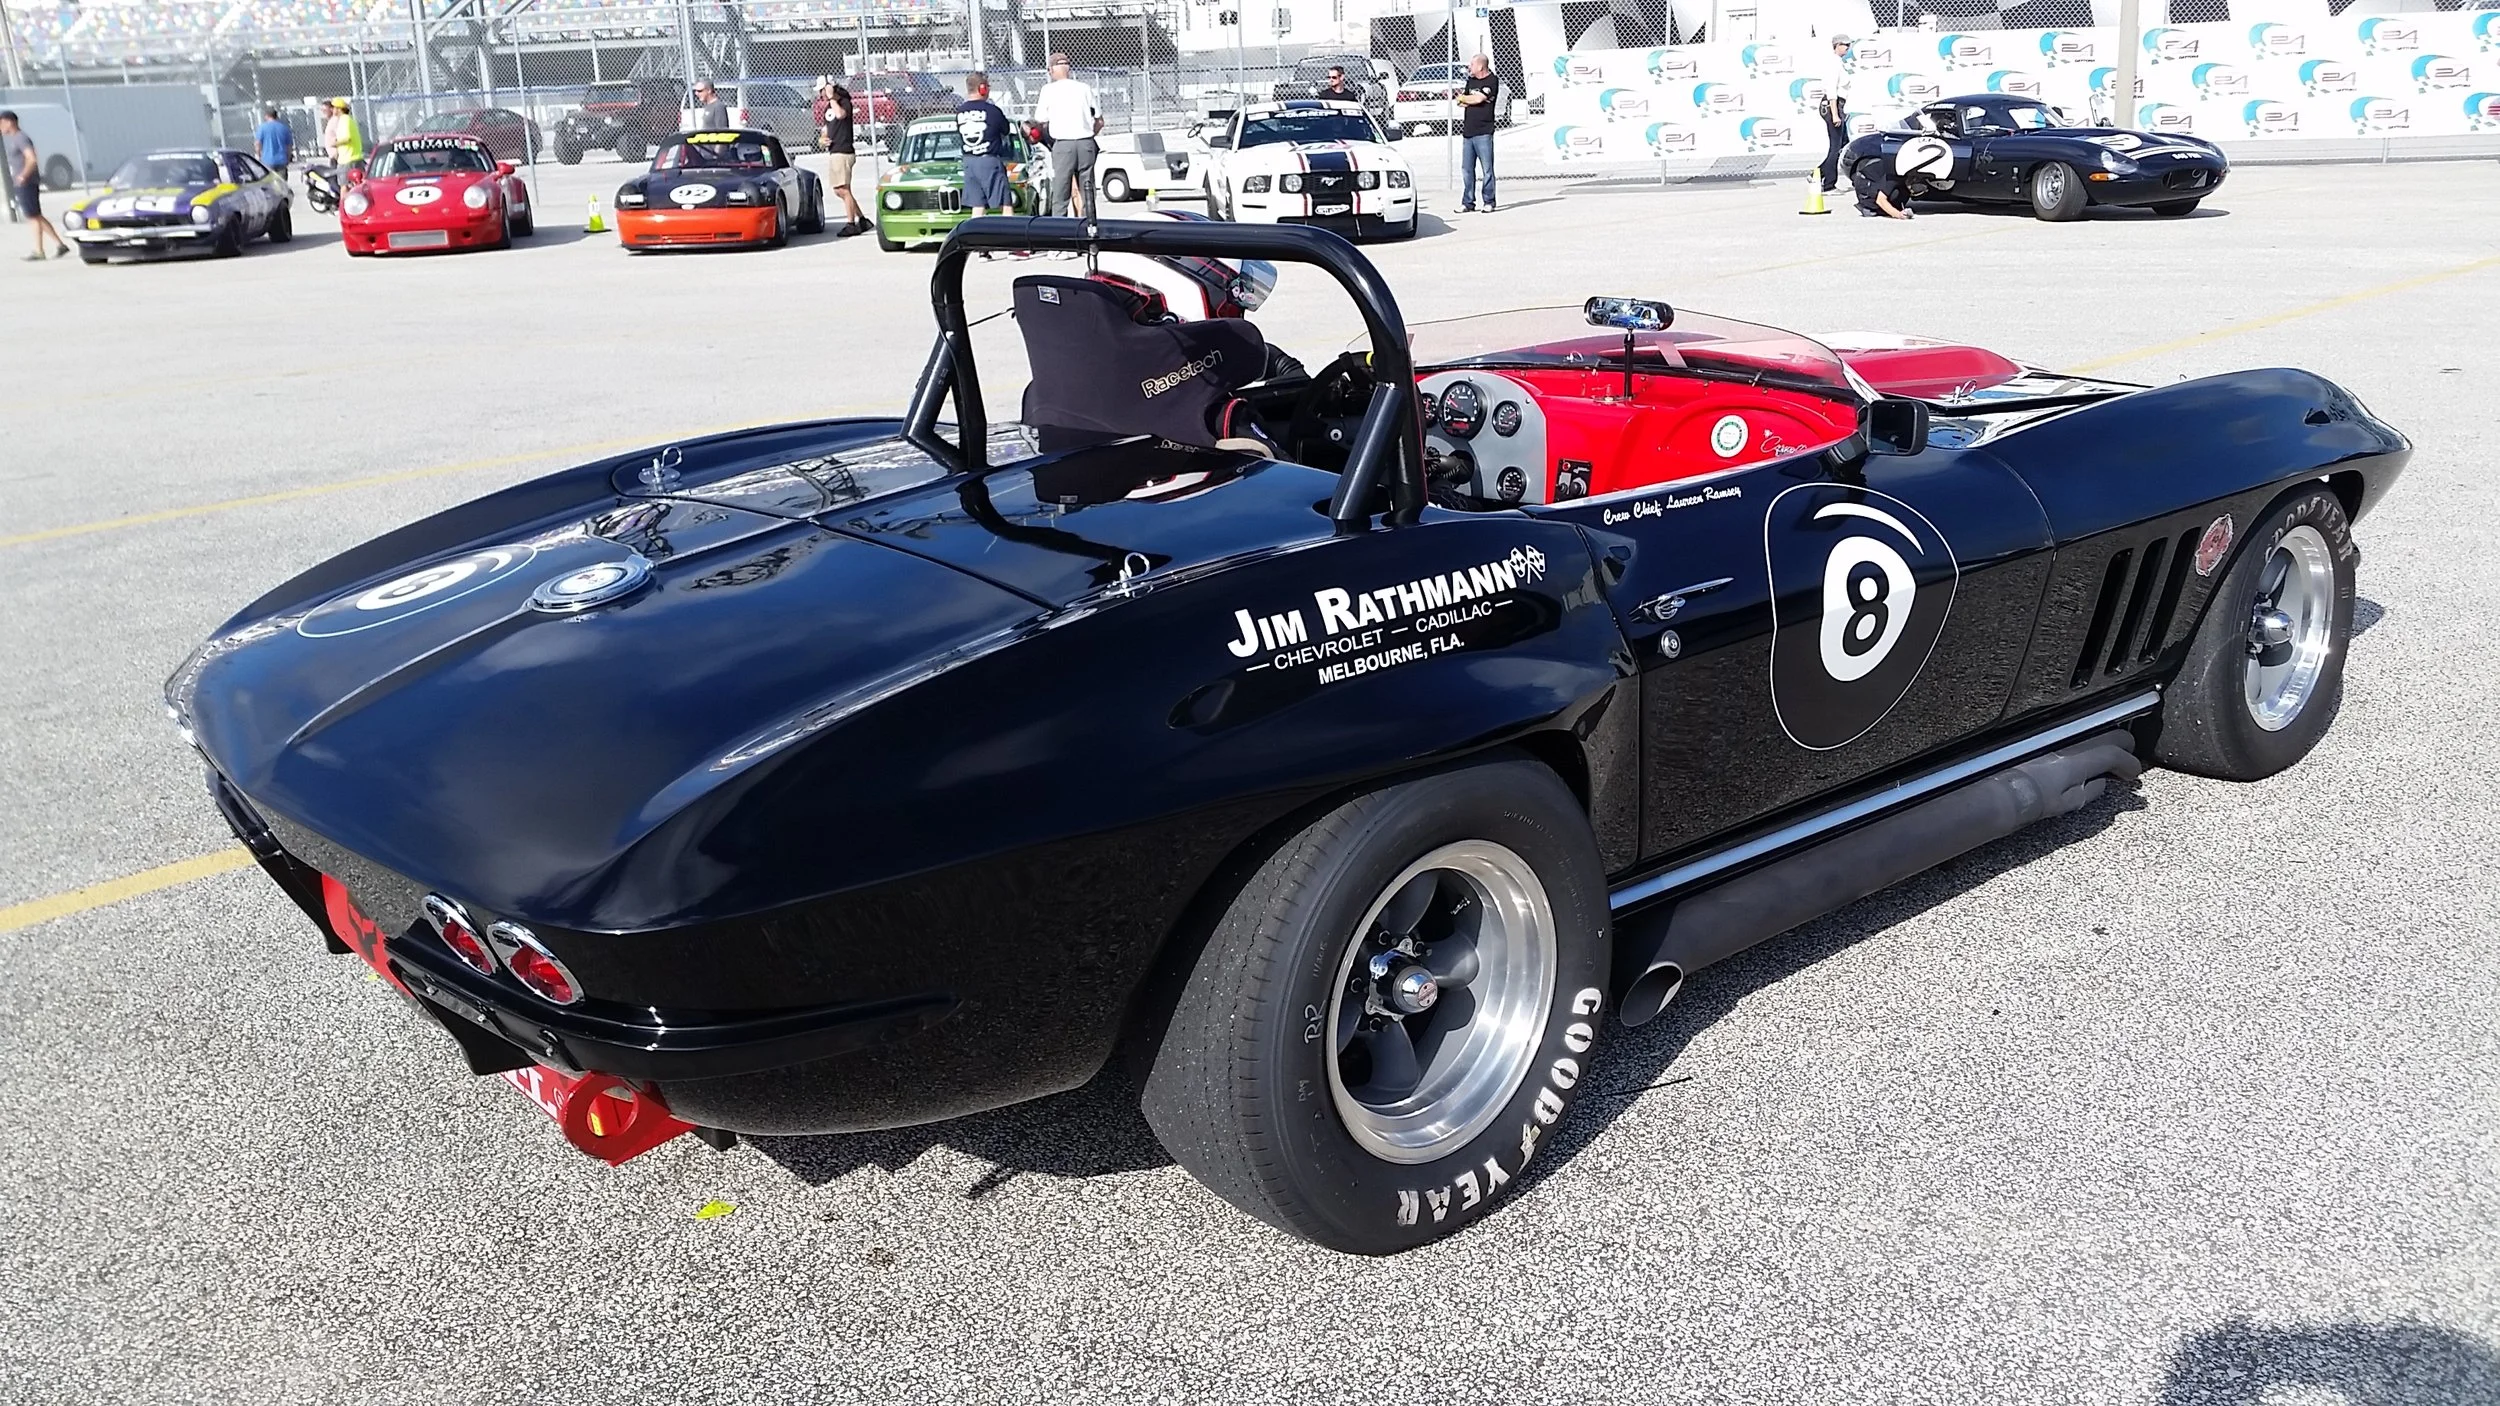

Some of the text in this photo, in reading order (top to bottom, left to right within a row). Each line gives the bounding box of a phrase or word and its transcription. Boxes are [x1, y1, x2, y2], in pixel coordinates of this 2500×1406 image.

[1908, 144, 1947, 180] 2
[408, 190, 430, 198] 14
[678, 186, 708, 198] 92
[1141, 349, 1223, 398] Racetech
[1603, 508, 1630, 526] Crew
[1634, 500, 1662, 517] Chief:
[1703, 486, 1742, 500] Ramsey
[1227, 560, 1518, 658] JIM RATHMANN
[1842, 560, 1889, 657] 8
[1274, 600, 1492, 670] CHEVROLET CADILLAC
[1318, 632, 1465, 685] MELBOURNE, FLA.
[1304, 999, 1326, 1044] RR
